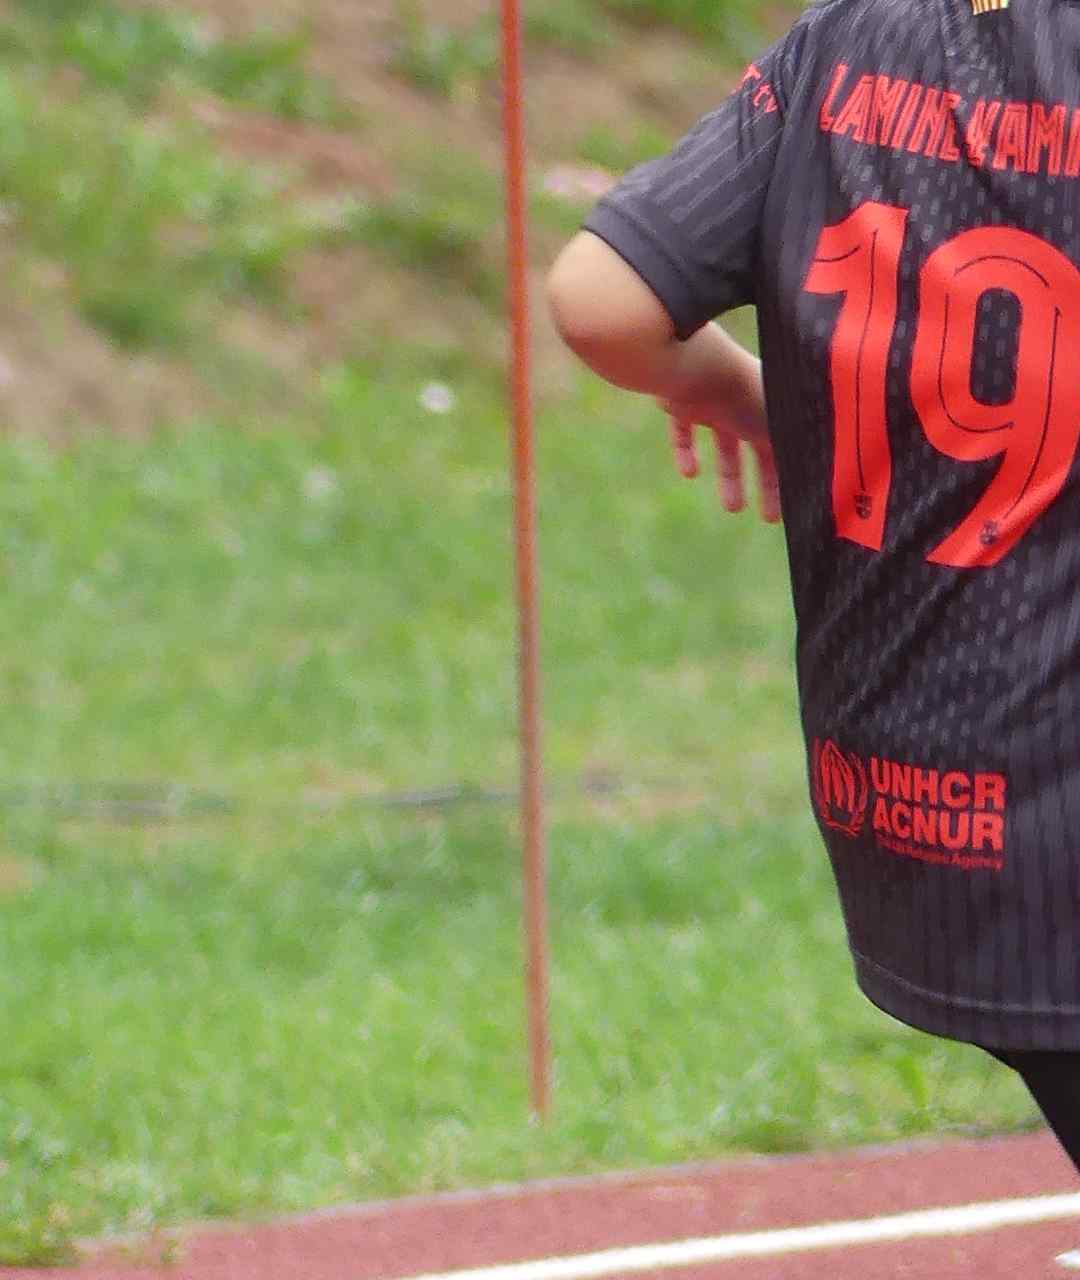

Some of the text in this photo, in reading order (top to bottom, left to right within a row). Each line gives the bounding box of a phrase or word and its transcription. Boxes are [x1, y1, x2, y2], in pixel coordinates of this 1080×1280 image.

[819, 62, 961, 162] LAMINE
[870, 756, 1007, 810] UNHCR
[872, 797, 1005, 851] ACNUR
